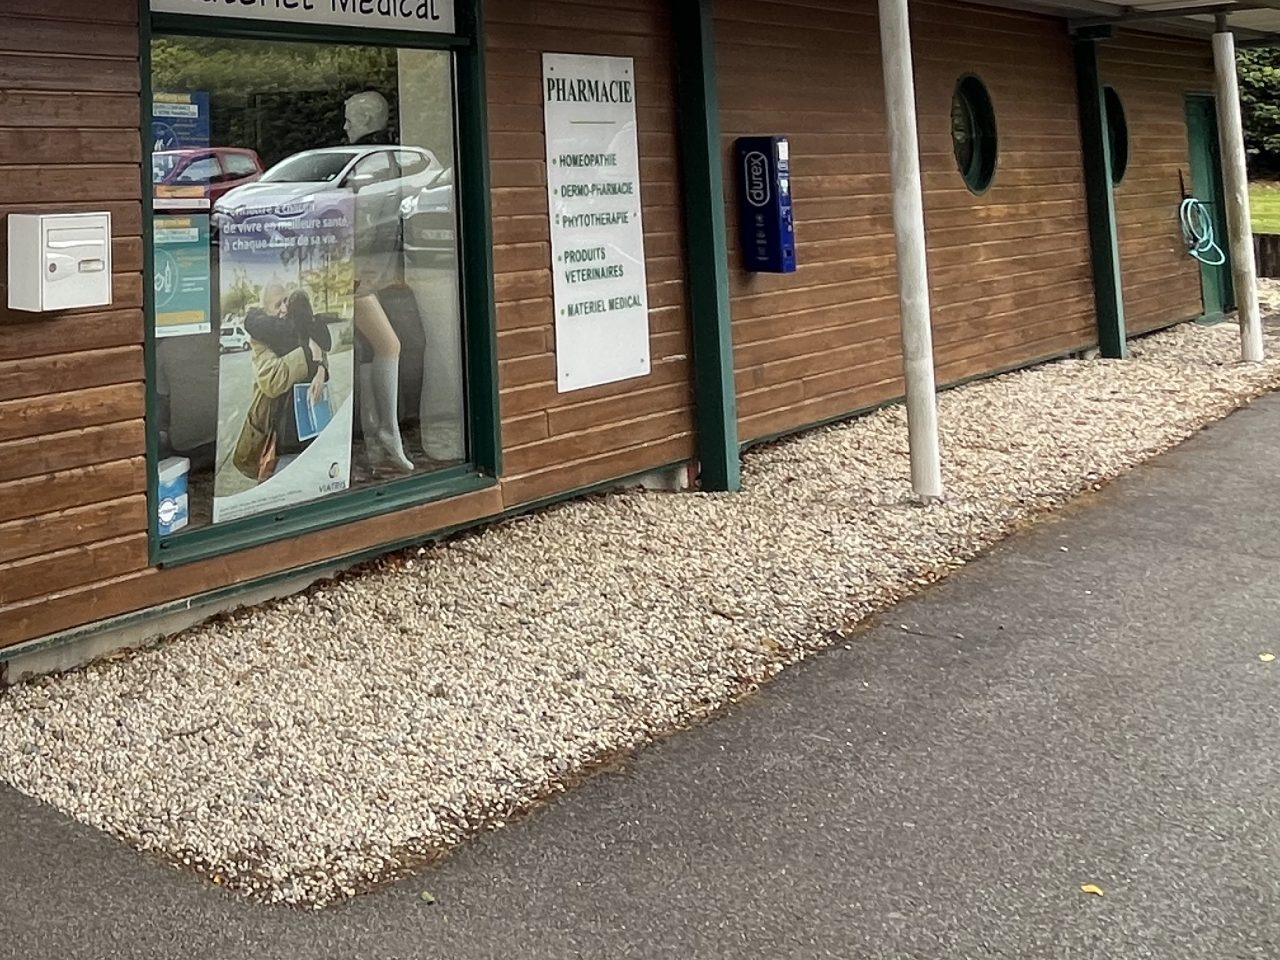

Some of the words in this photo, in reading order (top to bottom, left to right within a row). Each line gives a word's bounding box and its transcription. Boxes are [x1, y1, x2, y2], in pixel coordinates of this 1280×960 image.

[547, 78, 632, 103] PHARMACIE
[560, 153, 617, 167] HOMEOPATHIE
[750, 157, 765, 201] durex
[561, 182, 633, 197] DERMO-PHARMACIE
[223, 222, 236, 234] de
[238, 220, 262, 233] vivre
[277, 218, 320, 232] meilleure
[562, 211, 629, 228] PHYTOTHERAPIE
[232, 237, 267, 253] chaque
[297, 234, 309, 246] de
[310, 234, 322, 246] sa
[564, 247, 606, 263] PRODUITS
[565, 264, 624, 283] VETERINAIRES
[567, 300, 606, 317] MATERIEL
[608, 295, 642, 311] MEDICAL
